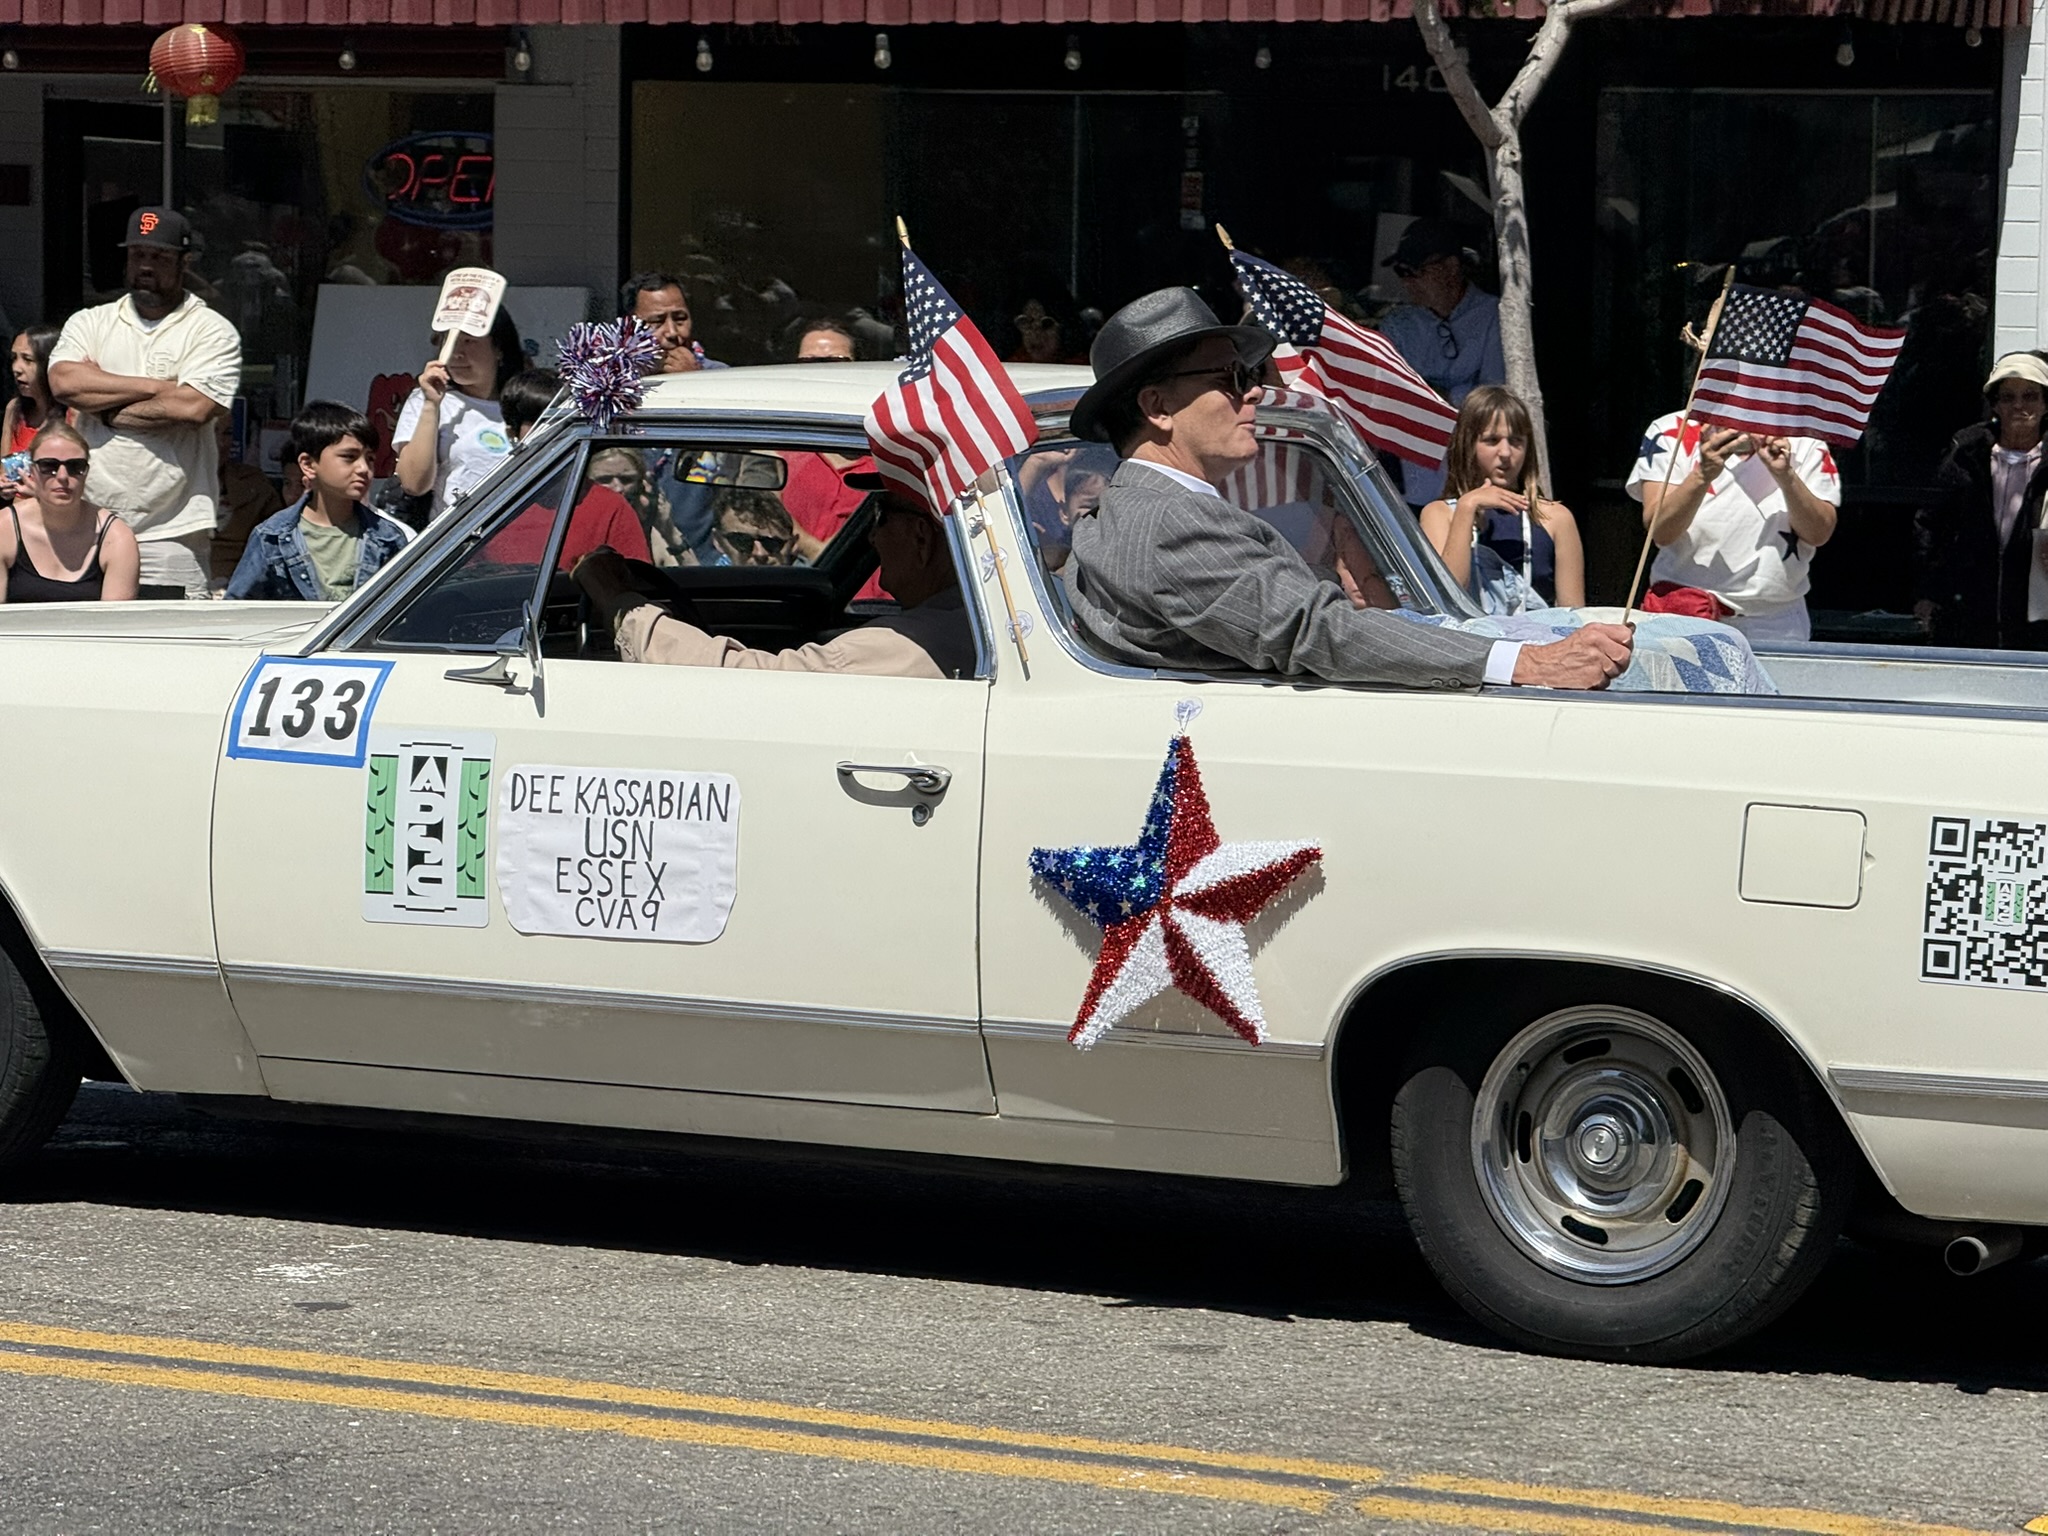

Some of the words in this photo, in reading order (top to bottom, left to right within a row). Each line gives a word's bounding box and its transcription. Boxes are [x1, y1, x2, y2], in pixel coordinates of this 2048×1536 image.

[248, 676, 366, 741] 133
[510, 772, 565, 814] DEE
[574, 775, 731, 823] KASSABIAN
[584, 816, 655, 862] USN
[556, 856, 667, 901] ESSEX
